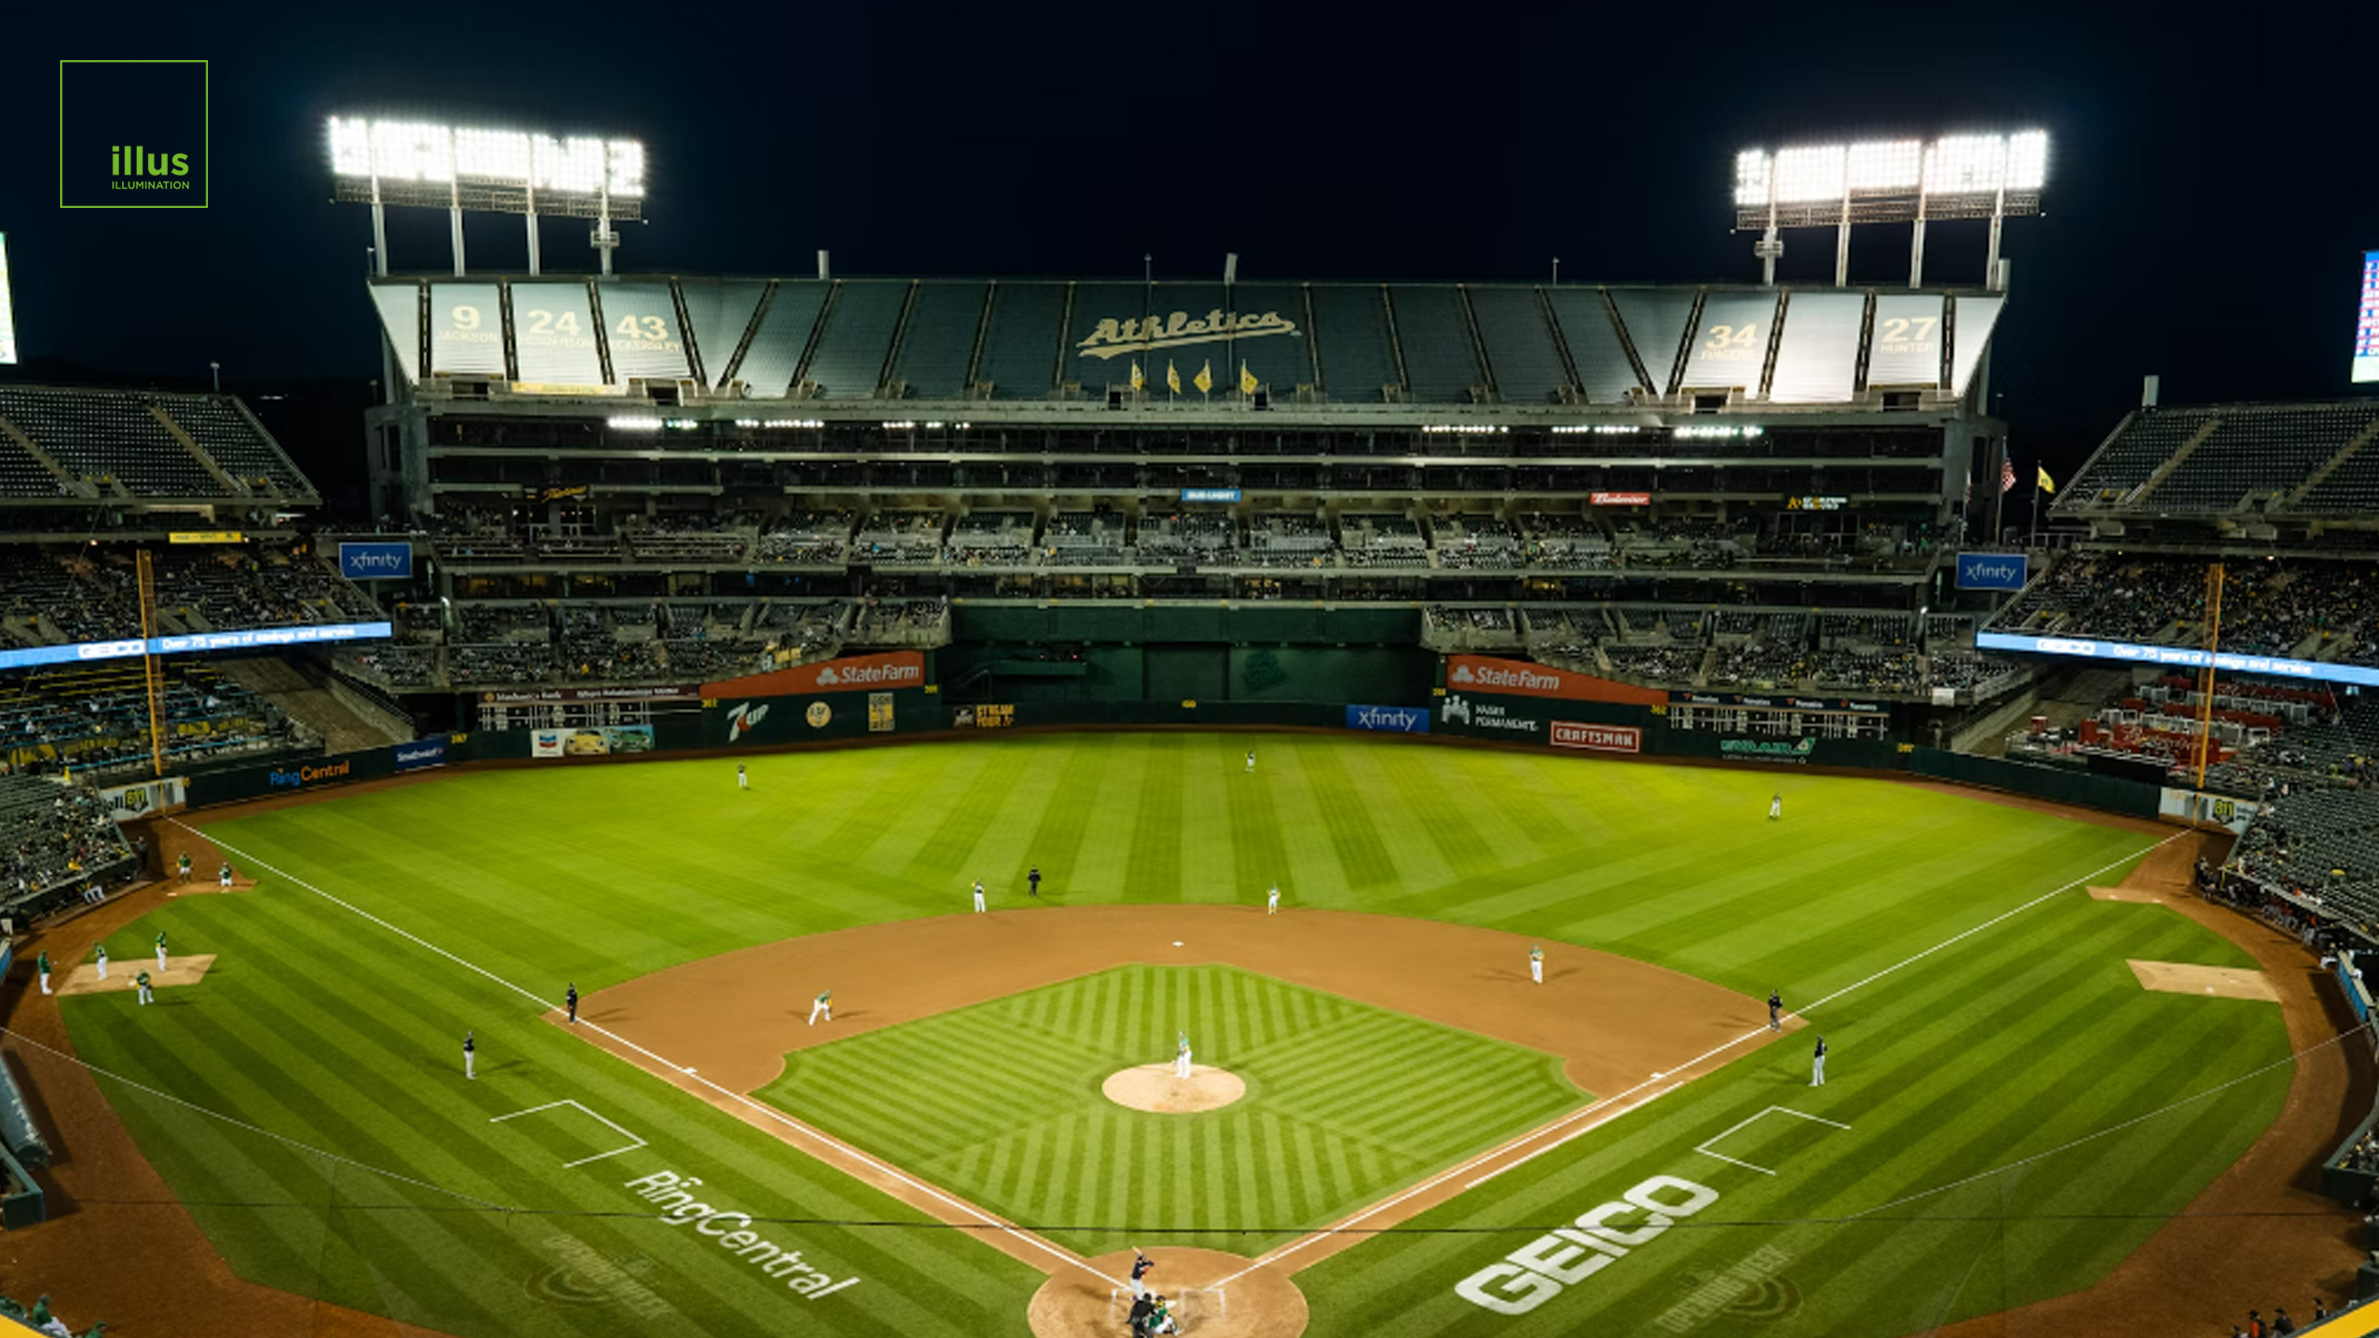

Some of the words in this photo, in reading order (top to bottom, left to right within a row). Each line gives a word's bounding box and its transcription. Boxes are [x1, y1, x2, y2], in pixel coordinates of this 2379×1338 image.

[452, 306, 481, 330] 9
[527, 310, 580, 336] 24
[616, 315, 668, 341] 43
[1881, 317, 1938, 342] 27
[438, 330, 498, 344] JACKSON
[1076, 309, 1296, 354] Athletics
[1705, 324, 1757, 349] 34
[1881, 341, 1934, 354] HUNTER
[1593, 493, 1648, 505] Budweiser
[351, 552, 402, 570] xfinity
[1965, 562, 2017, 582] xfinity
[78, 640, 146, 659] GEICO
[162, 637, 188, 650] Over
[190, 635, 206, 648] 75
[209, 634, 238, 649] years
[242, 632, 252, 644] of
[255, 630, 295, 645] savings
[299, 628, 317, 640] and
[319, 627, 355, 638] service
[2037, 638, 2095, 655] GEICO
[2113, 644, 2139, 657] Over
[2141, 646, 2158, 659] 75
[2160, 649, 2189, 664] years
[2191, 650, 2203, 663] of
[2205, 653, 2246, 670] savings
[2249, 656, 2270, 669] and
[2272, 660, 2312, 675] service
[727, 702, 769, 742] 7UP
[1358, 707, 1417, 731] xfinity
[1556, 729, 1634, 747] CRAFTSMAN
[397, 747, 437, 763] Southwest
[270, 760, 350, 787] RingCentral
[125, 788, 146, 806] 811
[2214, 799, 2235, 817] 811
[624, 1170, 861, 1300] RingCentral
[1454, 1175, 1719, 1315] GEICO
[1654, 1275, 1748, 1334] OPENING
[1727, 1244, 1794, 1283] WEEK
